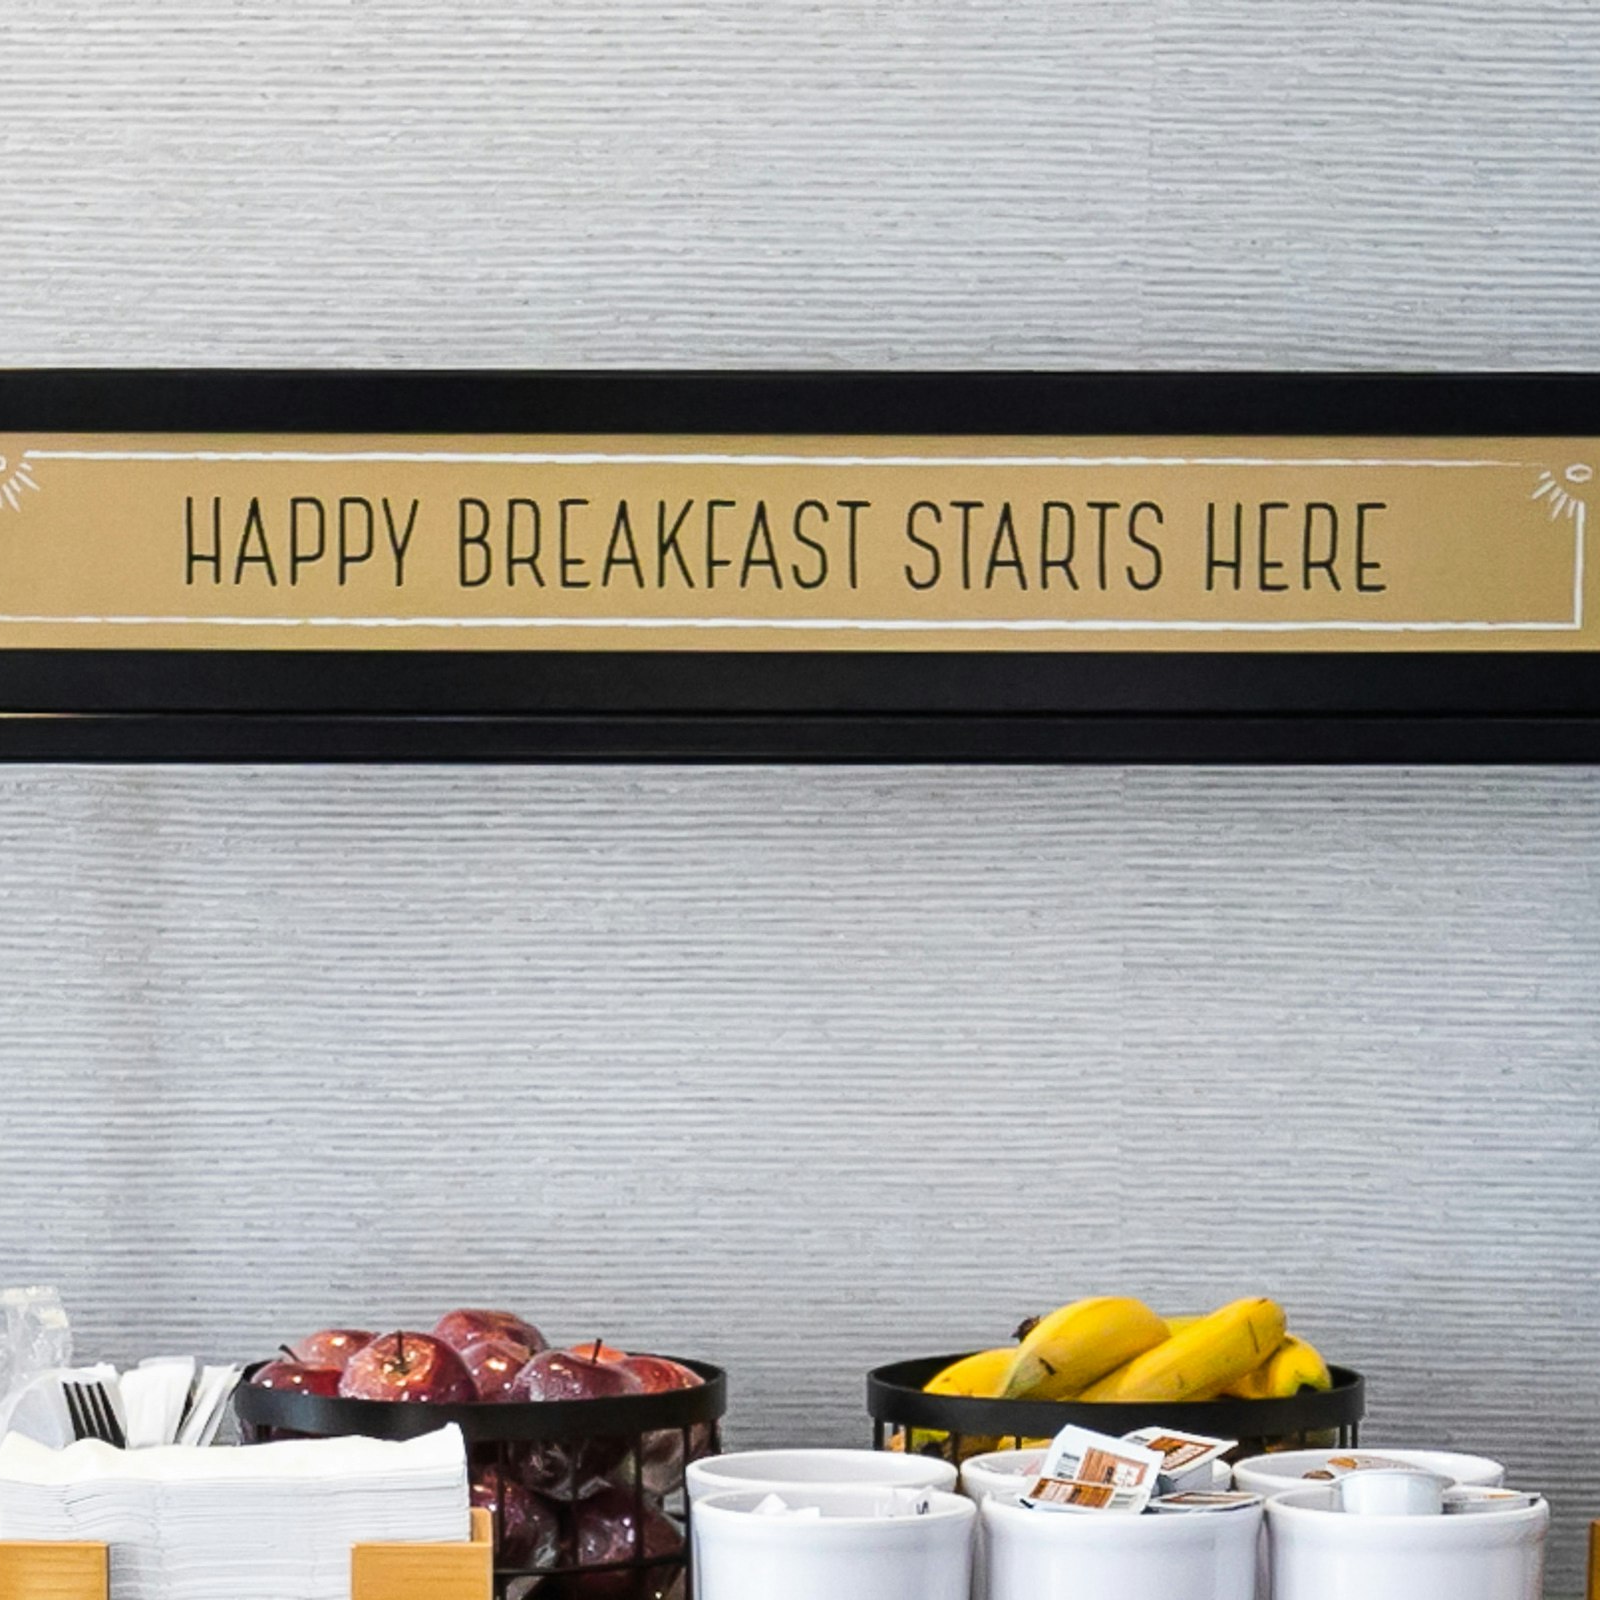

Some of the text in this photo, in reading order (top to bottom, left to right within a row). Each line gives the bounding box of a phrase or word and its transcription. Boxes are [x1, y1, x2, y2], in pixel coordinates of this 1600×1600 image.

[185, 496, 1388, 592] HAPPY BREAKFAST STARTS HERE
